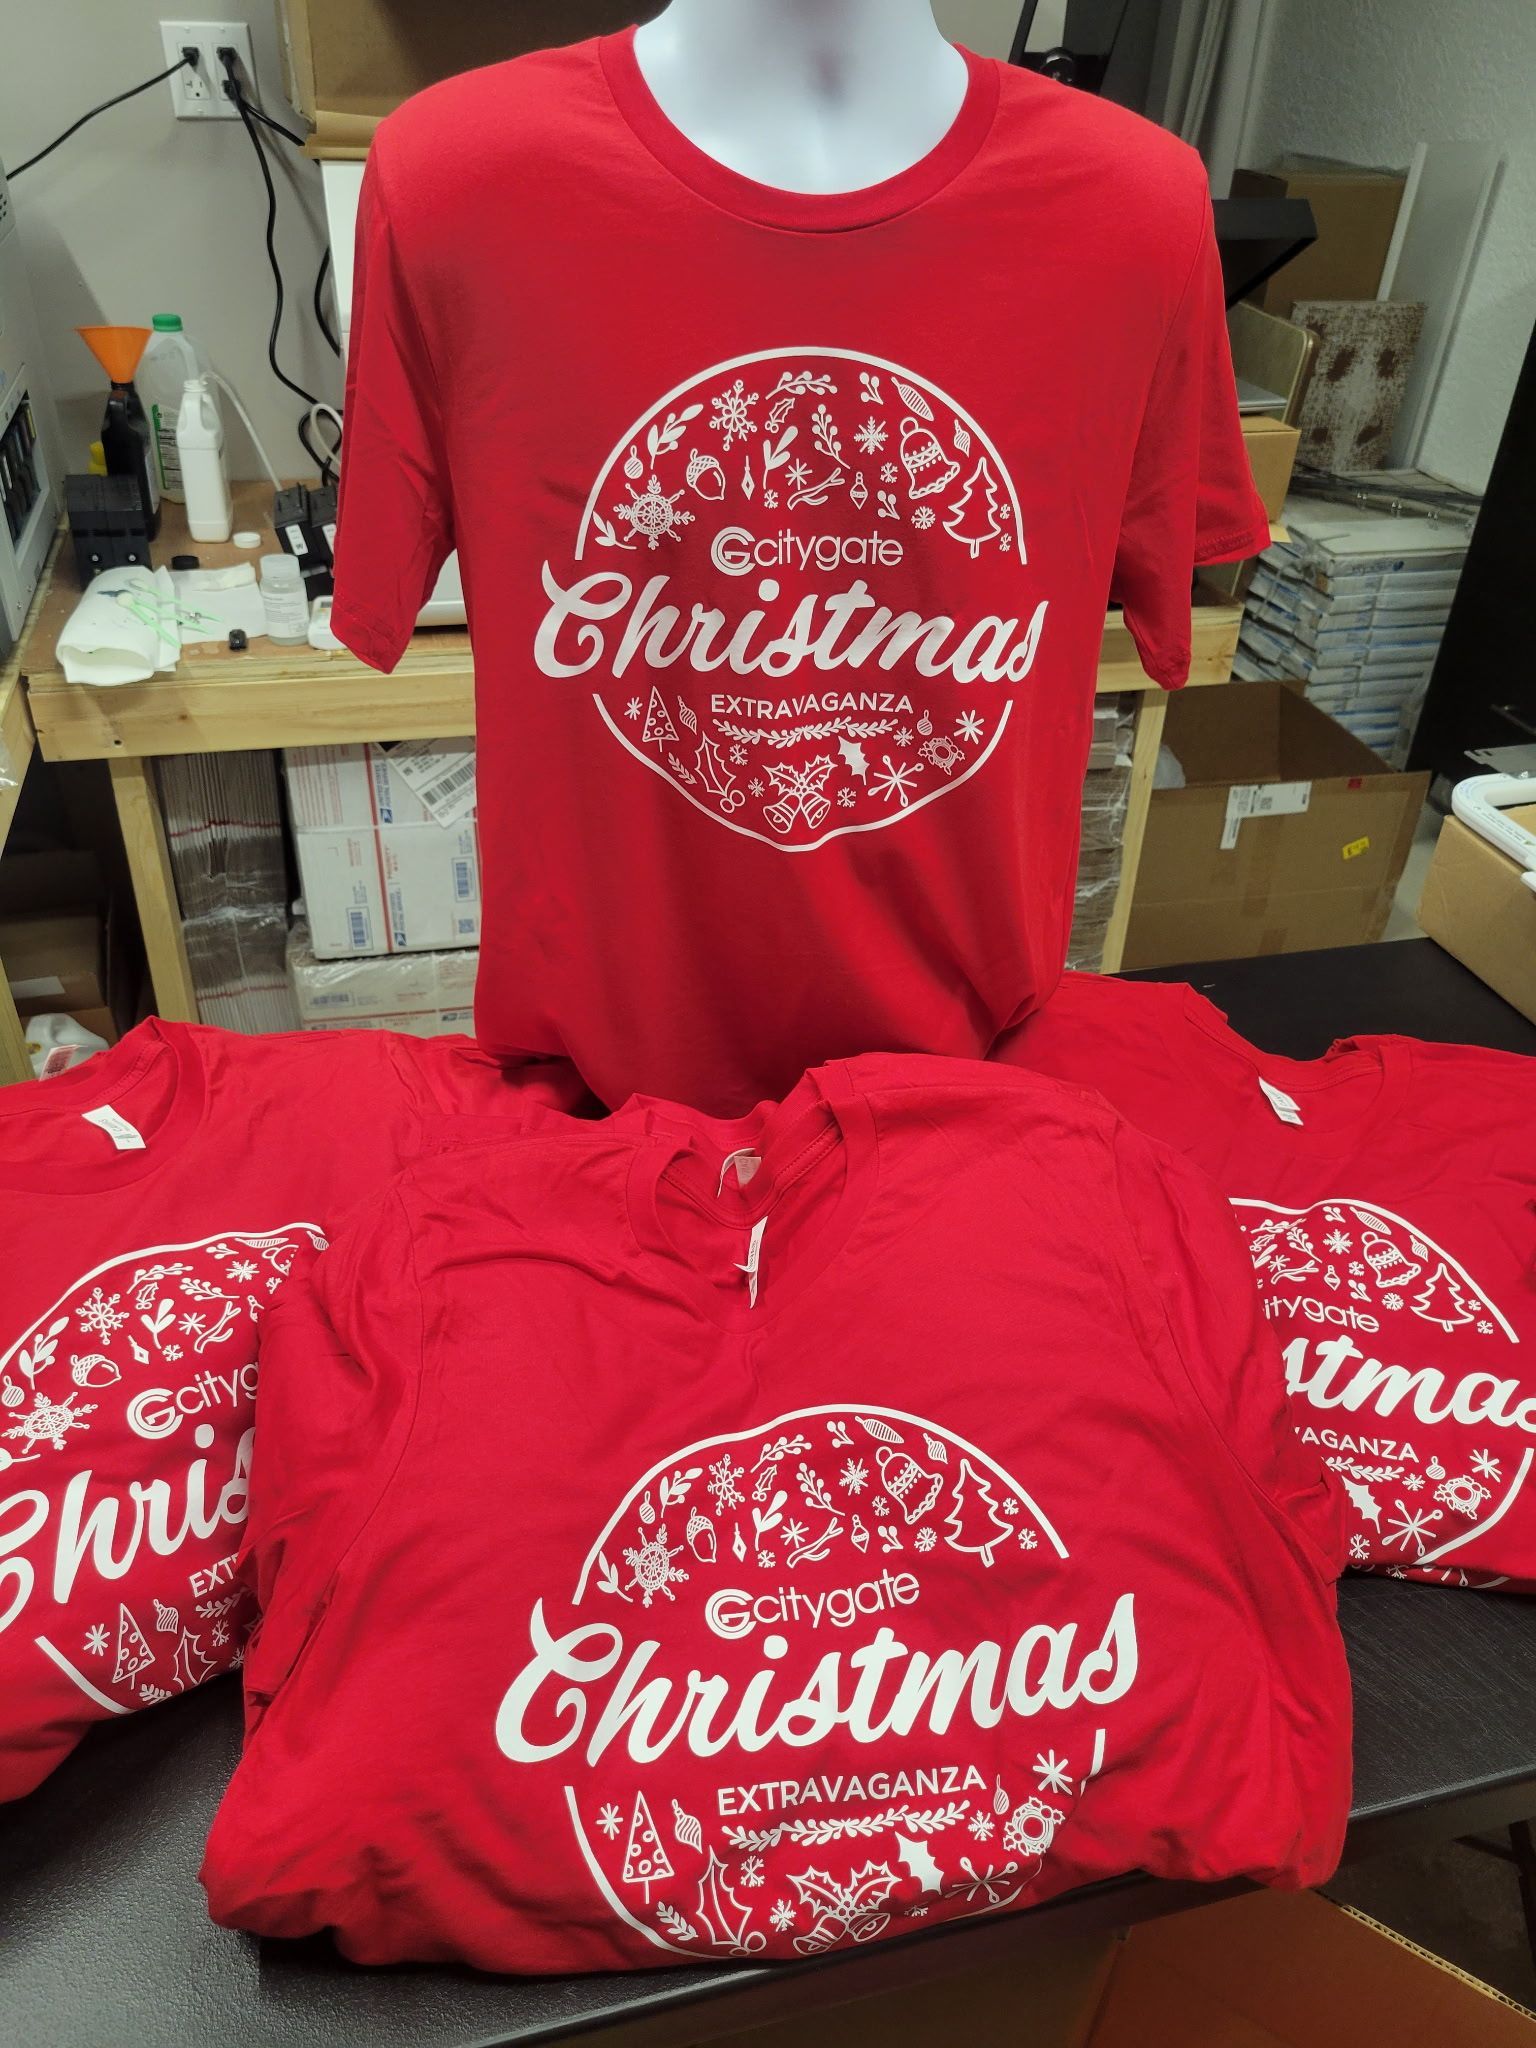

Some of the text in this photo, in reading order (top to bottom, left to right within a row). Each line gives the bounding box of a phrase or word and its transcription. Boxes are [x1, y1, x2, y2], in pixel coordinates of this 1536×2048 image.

[753, 528, 904, 571] citygate
[534, 560, 1050, 684] Christmas
[711, 691, 914, 720] EXTRAVAGANZA
[1294, 1426, 1420, 1463] AGANZA
[752, 1568, 920, 1628] citygate
[495, 1593, 1139, 1768] Christmas
[717, 1765, 988, 1816] EXTRAVAGANZA
